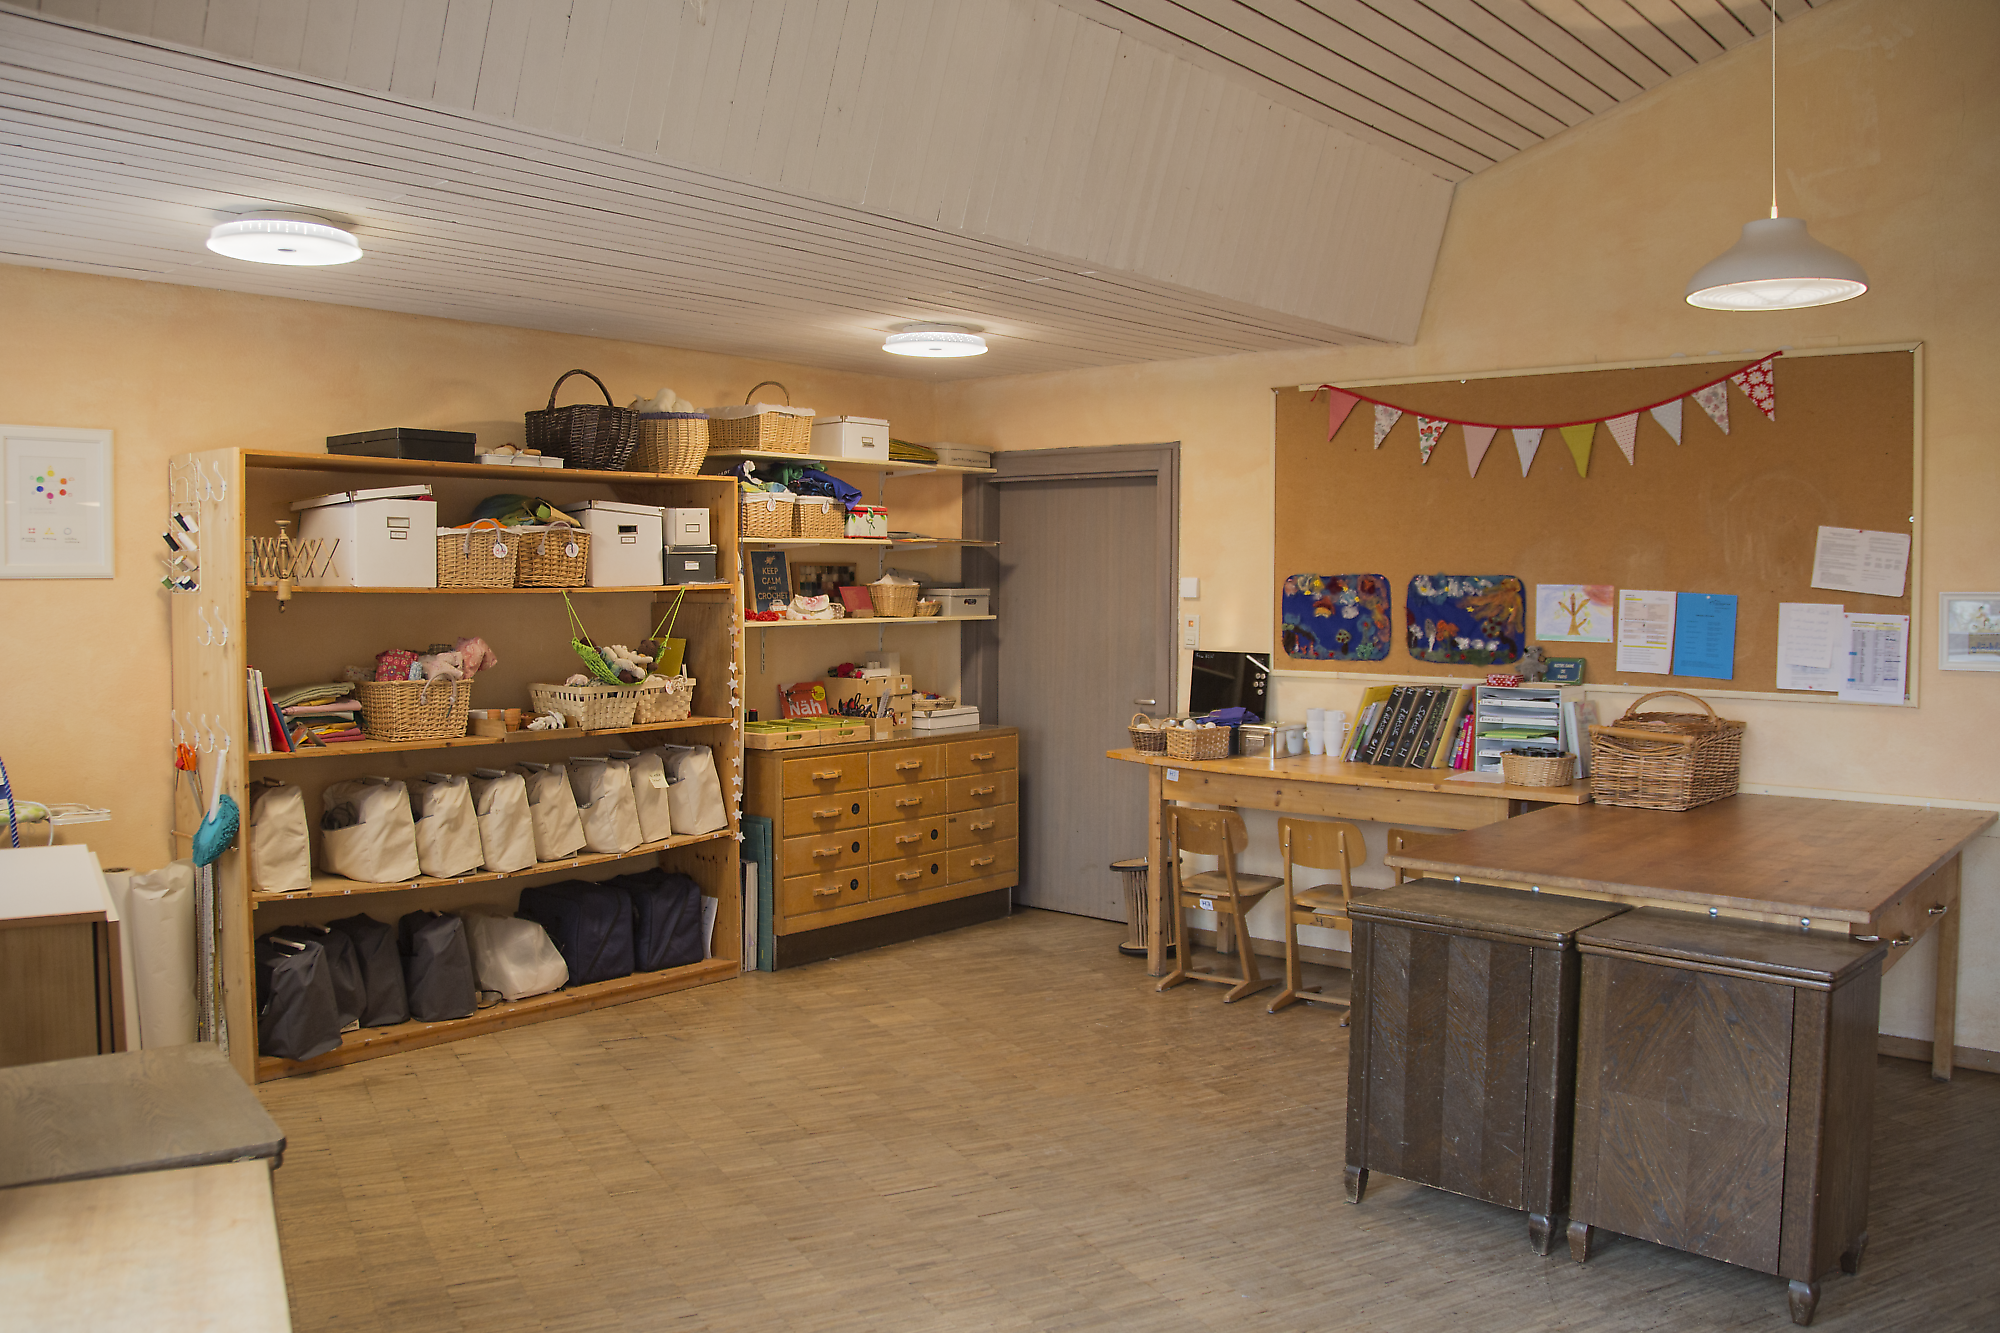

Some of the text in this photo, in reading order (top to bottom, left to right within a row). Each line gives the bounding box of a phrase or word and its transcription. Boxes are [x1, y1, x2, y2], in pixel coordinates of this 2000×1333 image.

[757, 591, 788, 600] CROCHET
[1393, 688, 1400, 697] H
[789, 699, 823, 716] Näh
[1366, 746, 1376, 755] H
[1383, 747, 1393, 757] H
[1398, 747, 1408, 757] H
